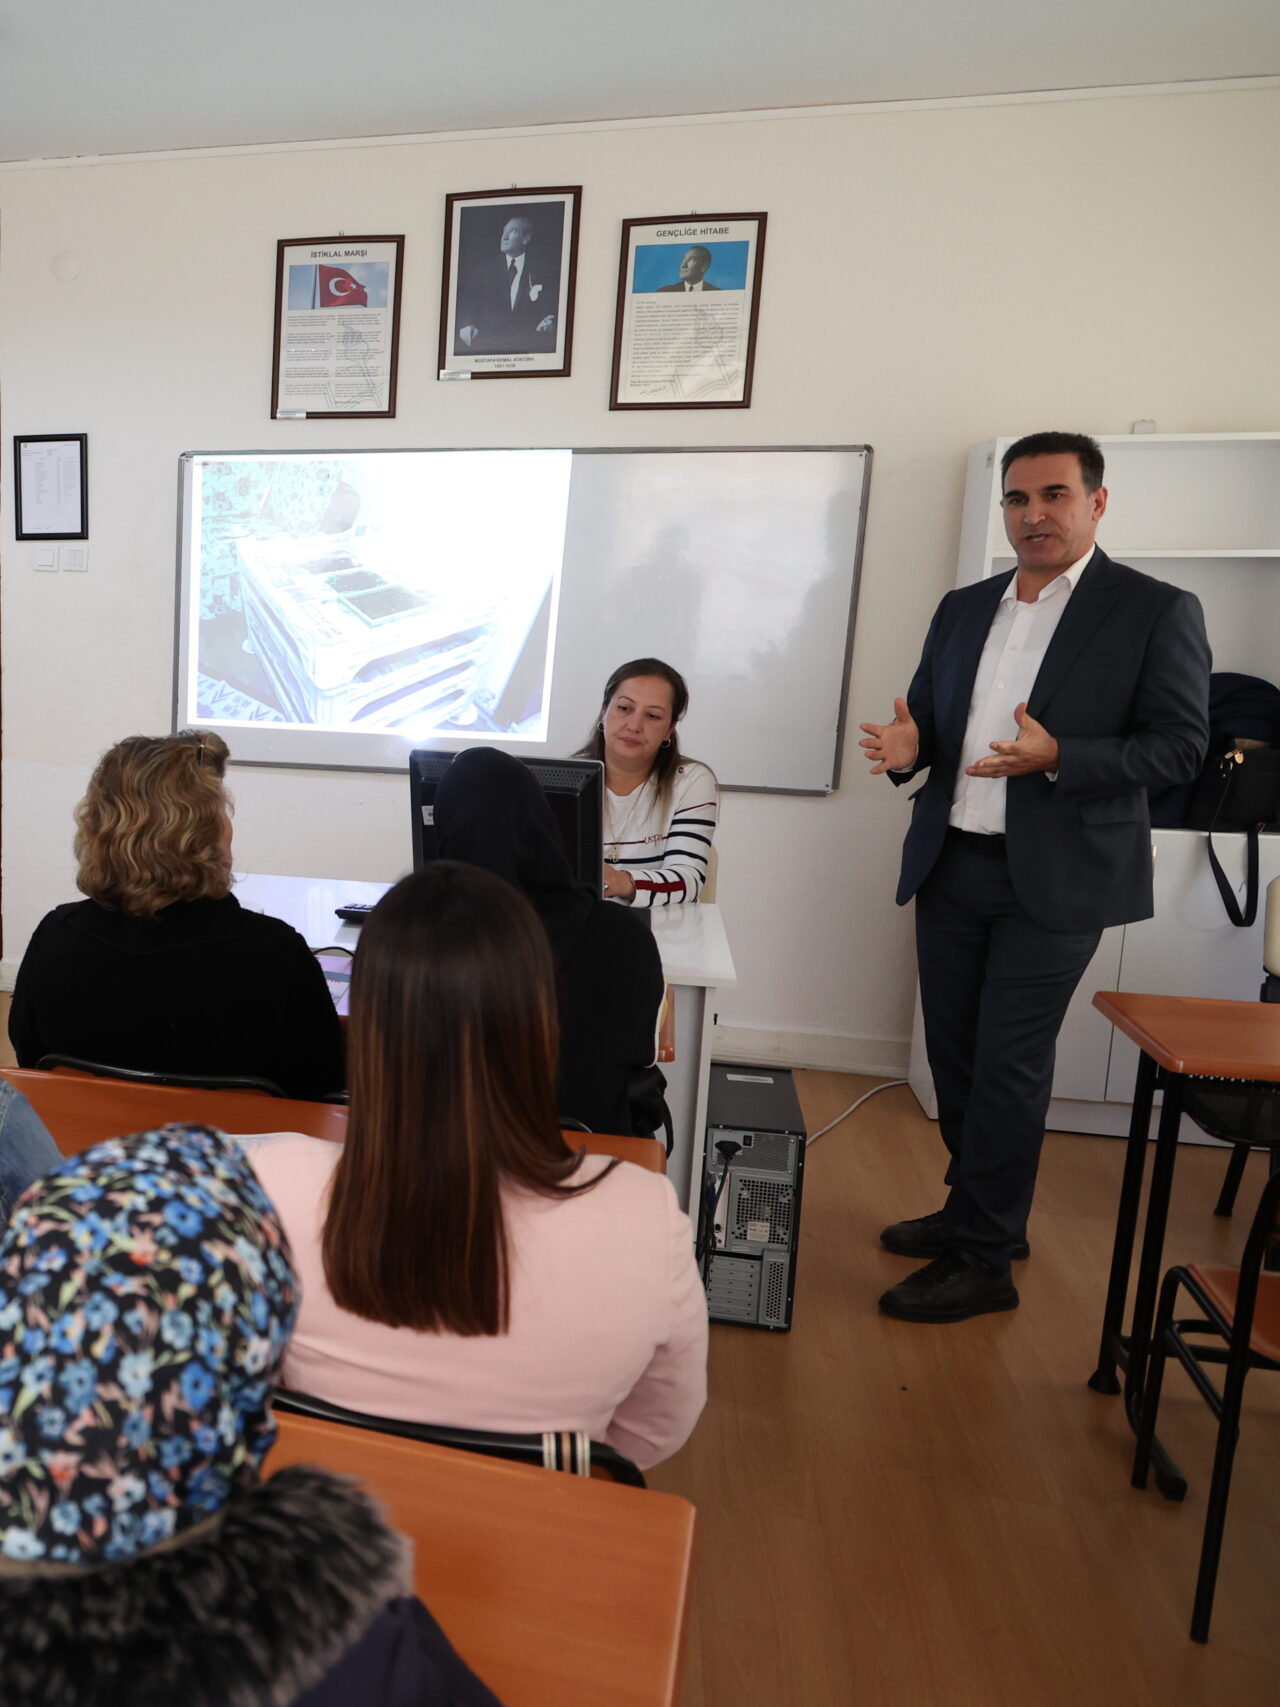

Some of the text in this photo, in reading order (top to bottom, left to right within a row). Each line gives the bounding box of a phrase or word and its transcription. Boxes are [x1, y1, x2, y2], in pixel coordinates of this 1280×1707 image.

[656, 226, 730, 237] GENÇLİĞE HİTABE
[310, 249, 368, 258] İSTİKLAL MARŞI
